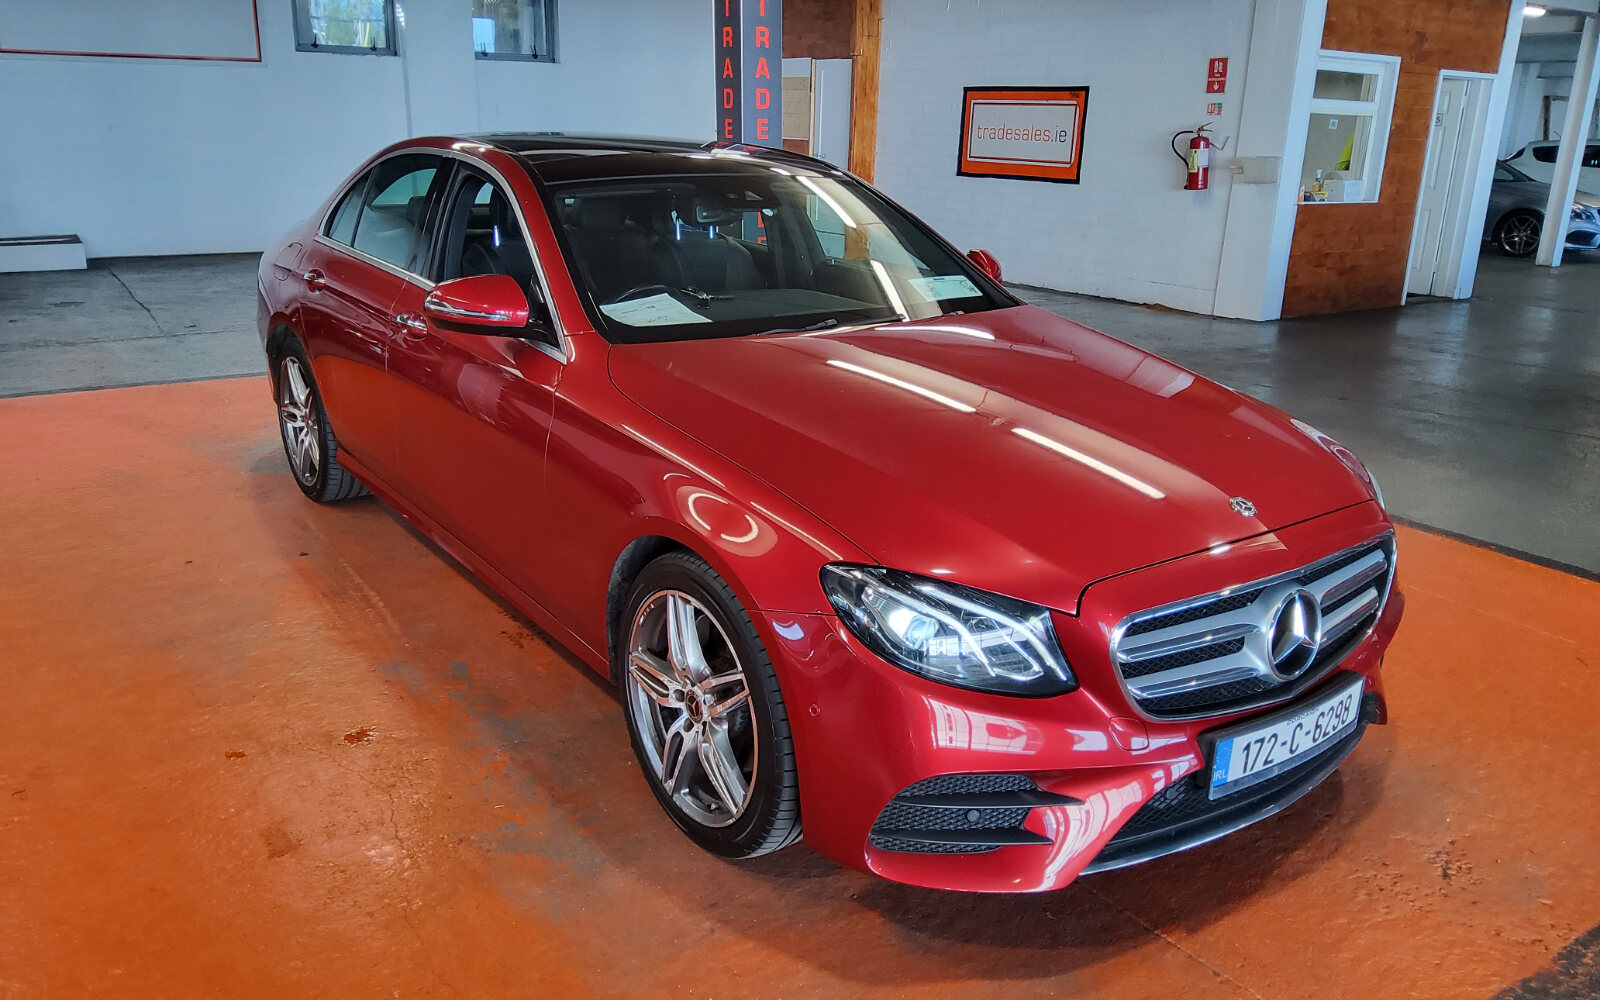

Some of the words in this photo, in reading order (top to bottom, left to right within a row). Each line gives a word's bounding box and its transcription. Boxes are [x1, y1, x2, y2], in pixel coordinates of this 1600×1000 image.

[977, 123, 1067, 143] tradesales.ie
[1242, 693, 1353, 775] 172-C-6298
[1212, 769, 1228, 782] IRL
